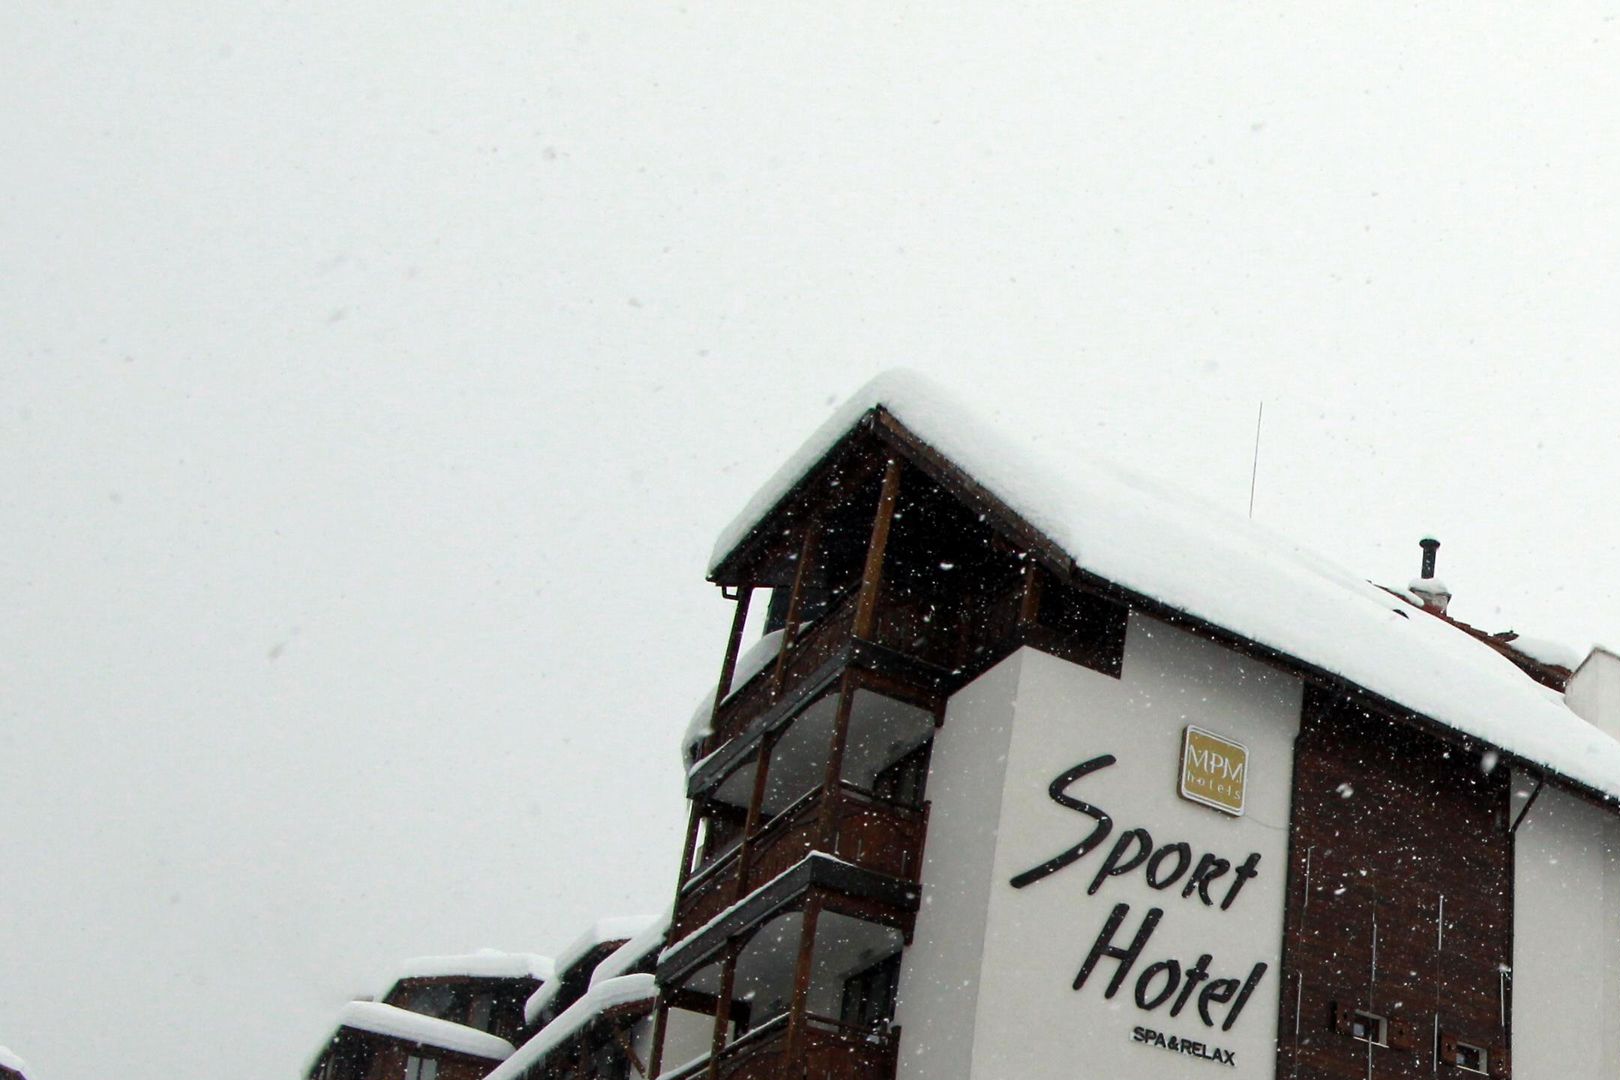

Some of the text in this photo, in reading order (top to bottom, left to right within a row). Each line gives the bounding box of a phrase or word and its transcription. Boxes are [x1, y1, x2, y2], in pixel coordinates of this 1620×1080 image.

[1188, 744, 1243, 784] MPM
[1187, 770, 1241, 800] hotels
[1072, 903, 1267, 1031] Hotel
